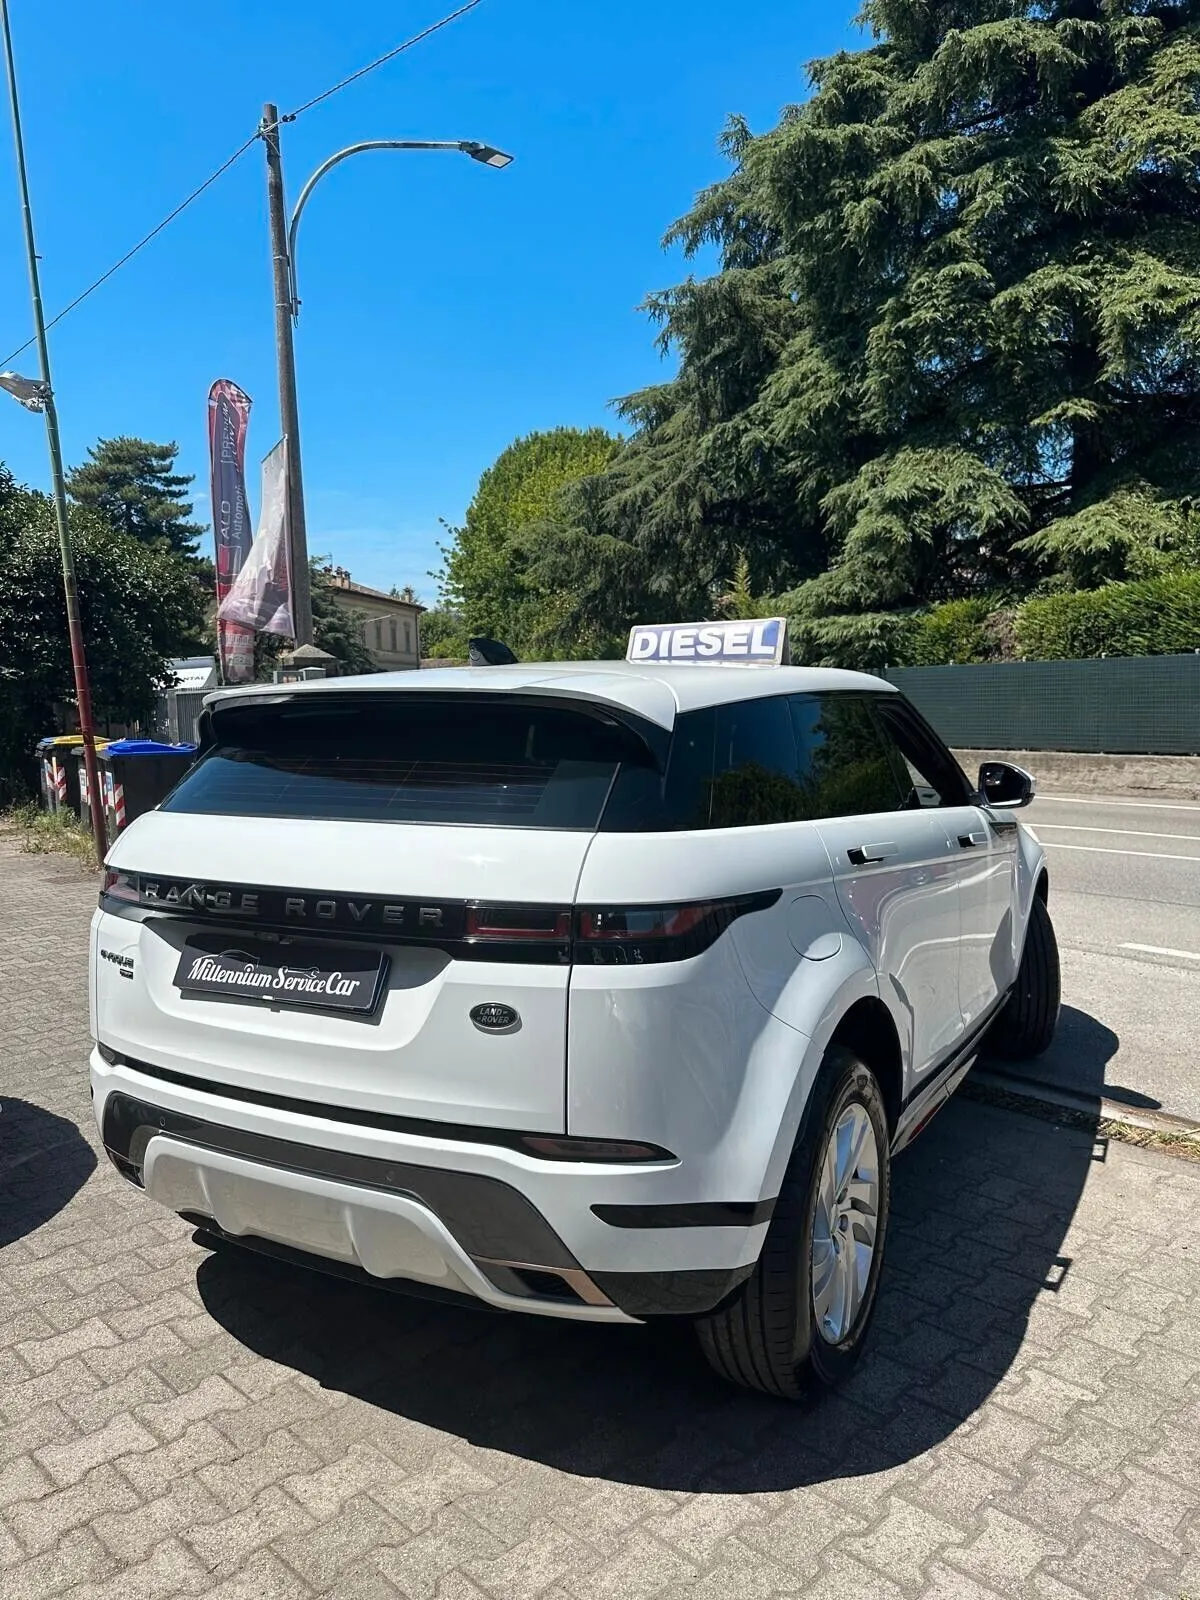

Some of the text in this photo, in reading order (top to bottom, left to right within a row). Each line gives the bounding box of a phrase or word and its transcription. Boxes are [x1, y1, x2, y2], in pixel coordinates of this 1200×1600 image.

[221, 500, 231, 540] ALD
[631, 625, 775, 659] DIESEL
[145, 882, 444, 928] RANGE ROVER
[187, 957, 272, 988] Millennium
[480, 1007, 503, 1016] LAND
[481, 1015, 510, 1024] ROVER
